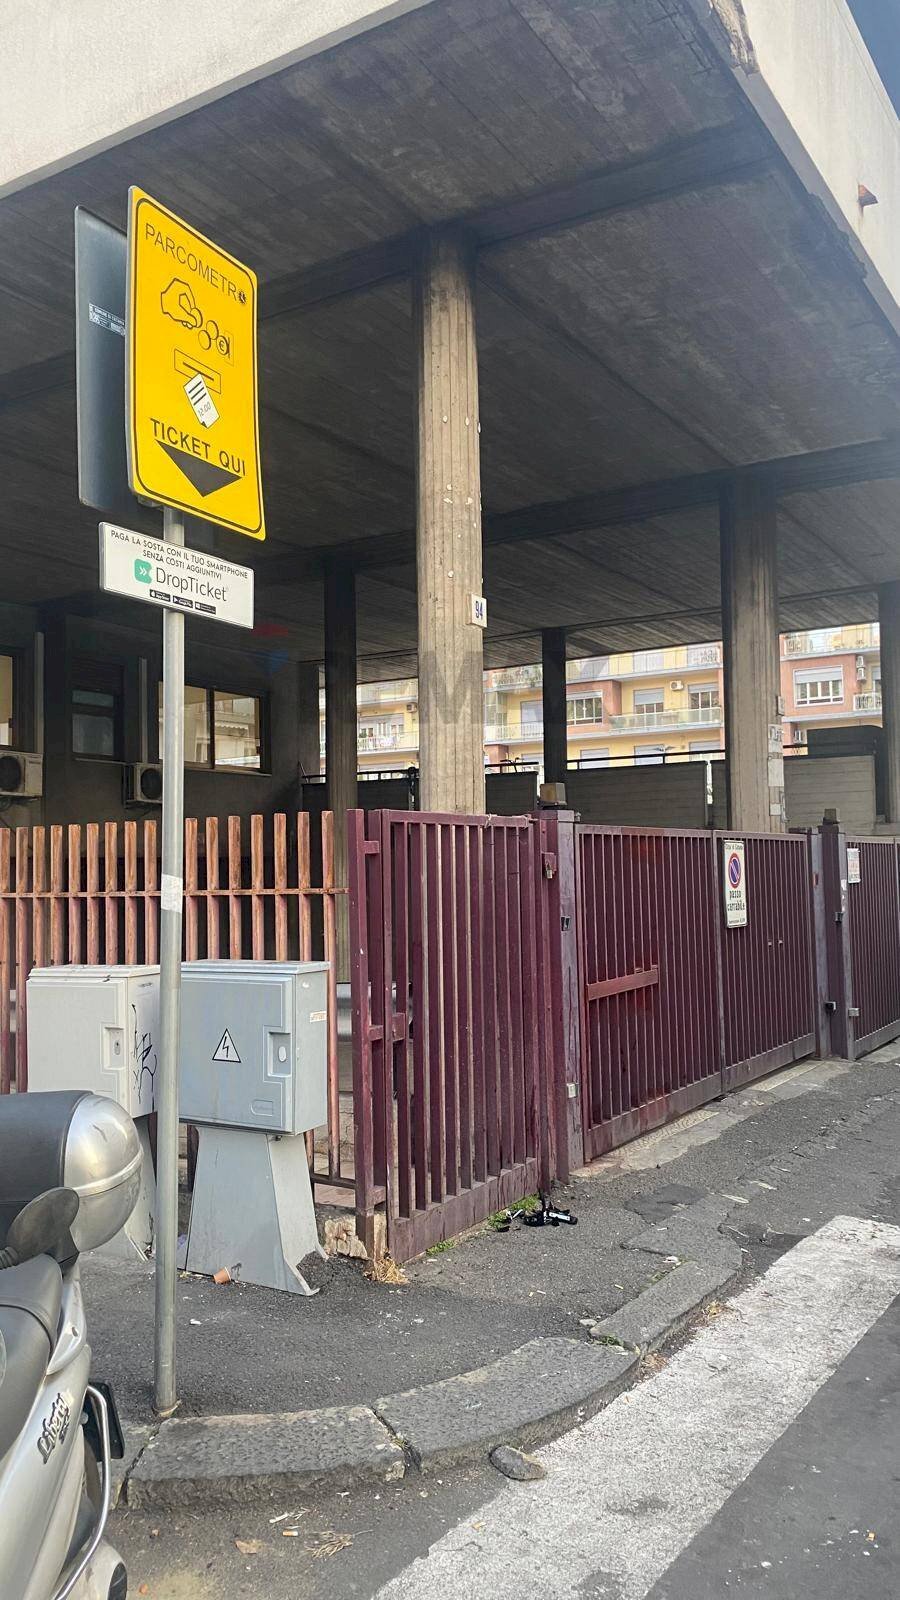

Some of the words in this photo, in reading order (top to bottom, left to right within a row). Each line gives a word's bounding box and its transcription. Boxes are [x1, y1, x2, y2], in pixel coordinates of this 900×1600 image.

[150, 418, 211, 459] TICKET
[218, 450, 246, 476] QUI
[111, 530, 129, 542] PAGA
[132, 537, 141, 546] LA
[143, 540, 165, 553] SOSTA
[166, 548, 182, 557] CON
[183, 552, 189, 560] IL
[191, 555, 205, 565] TUO
[206, 560, 248, 579] SMARTPHONE
[143, 550, 164, 563] SENZA
[166, 556, 185, 568] COSTI
[186, 564, 222, 580] AGGIUNTIVI
[156, 567, 227, 602] DropTicket
[475, 600, 483, 620] 94
[729, 890, 742, 900] passo
